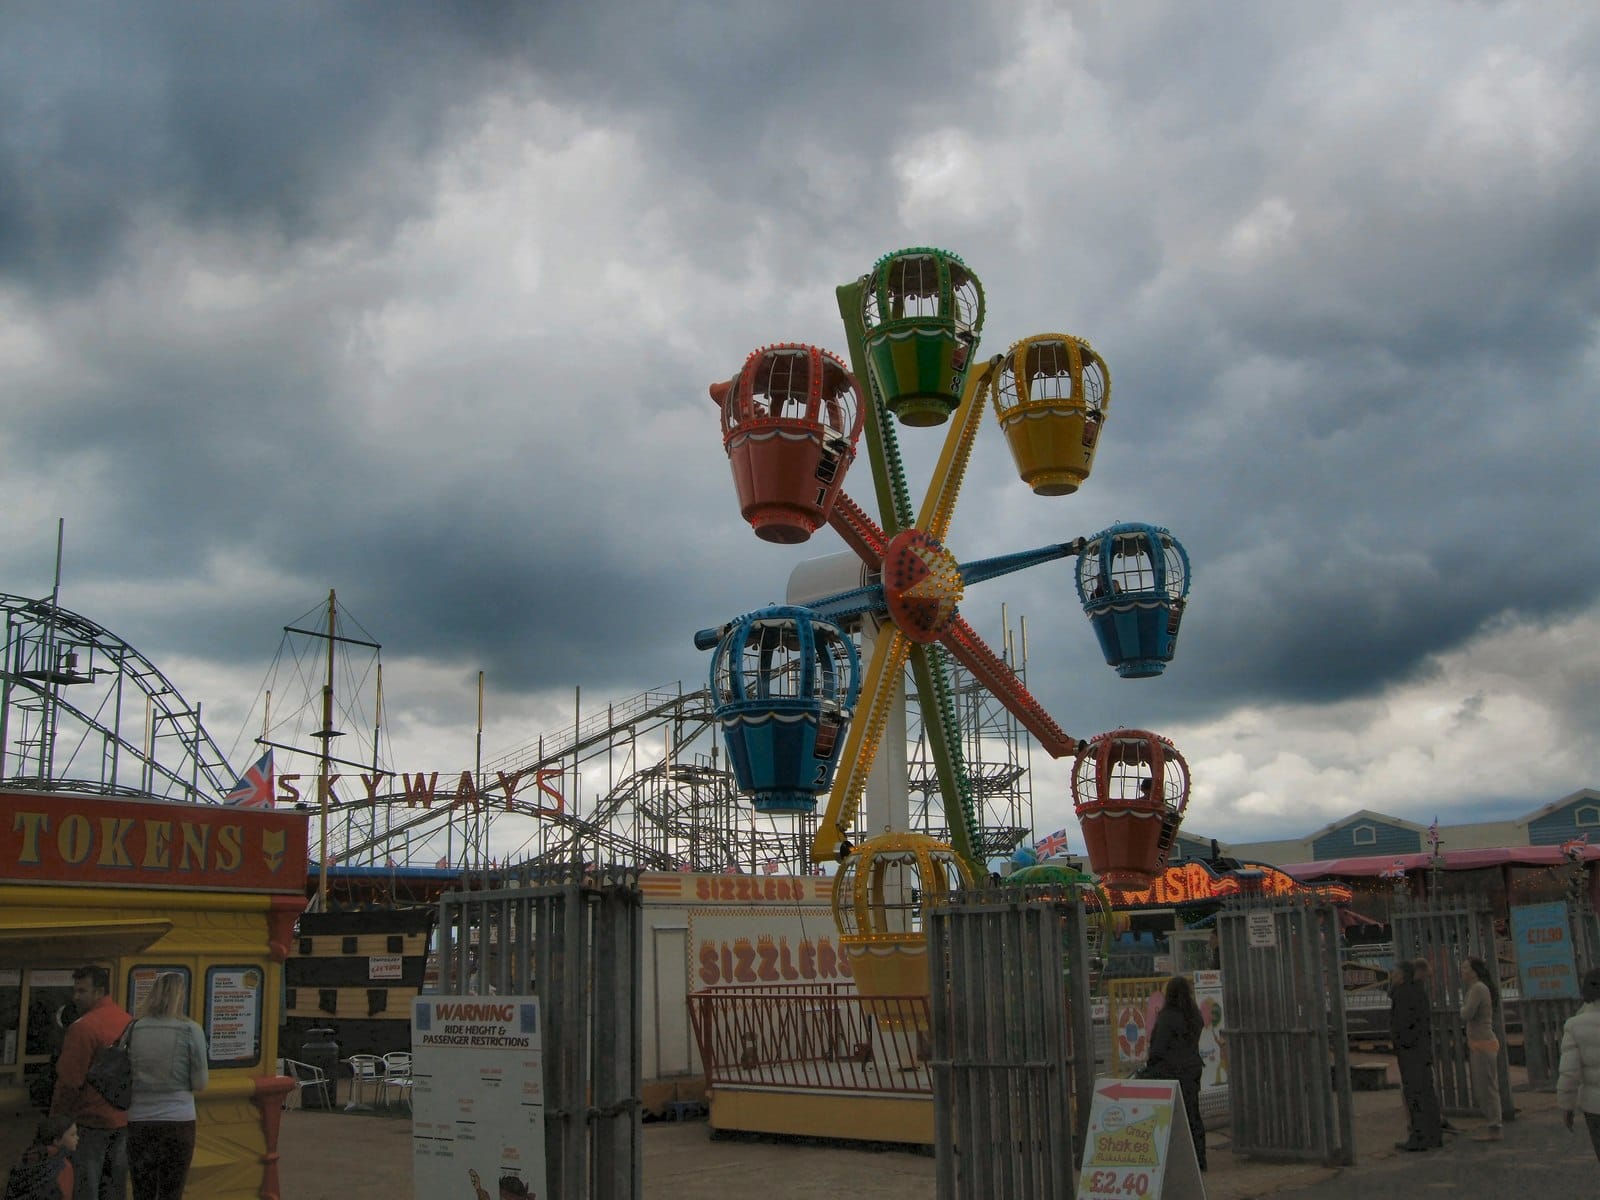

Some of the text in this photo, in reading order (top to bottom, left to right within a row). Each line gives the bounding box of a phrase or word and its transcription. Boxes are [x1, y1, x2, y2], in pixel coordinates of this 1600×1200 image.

[949, 375, 962, 393] 8
[1083, 451, 1091, 464] 7
[814, 487, 827, 507] 1
[811, 765, 828, 786] 2
[277, 768, 565, 817] SKYWAYS
[12, 812, 244, 873] TOKENS
[696, 876, 805, 901] SIZZLERS
[699, 934, 854, 985] SIZZLERS
[436, 1003, 514, 1022] WARNING
[444, 1024, 506, 1036] RIDE HEIGHT &
[423, 1034, 530, 1048] PASSENGER RESTRICTIONS
[1126, 1125, 1152, 1142] Crazy
[1098, 1136, 1150, 1153] Shakes
[1089, 1170, 1149, 1196] £2.40
